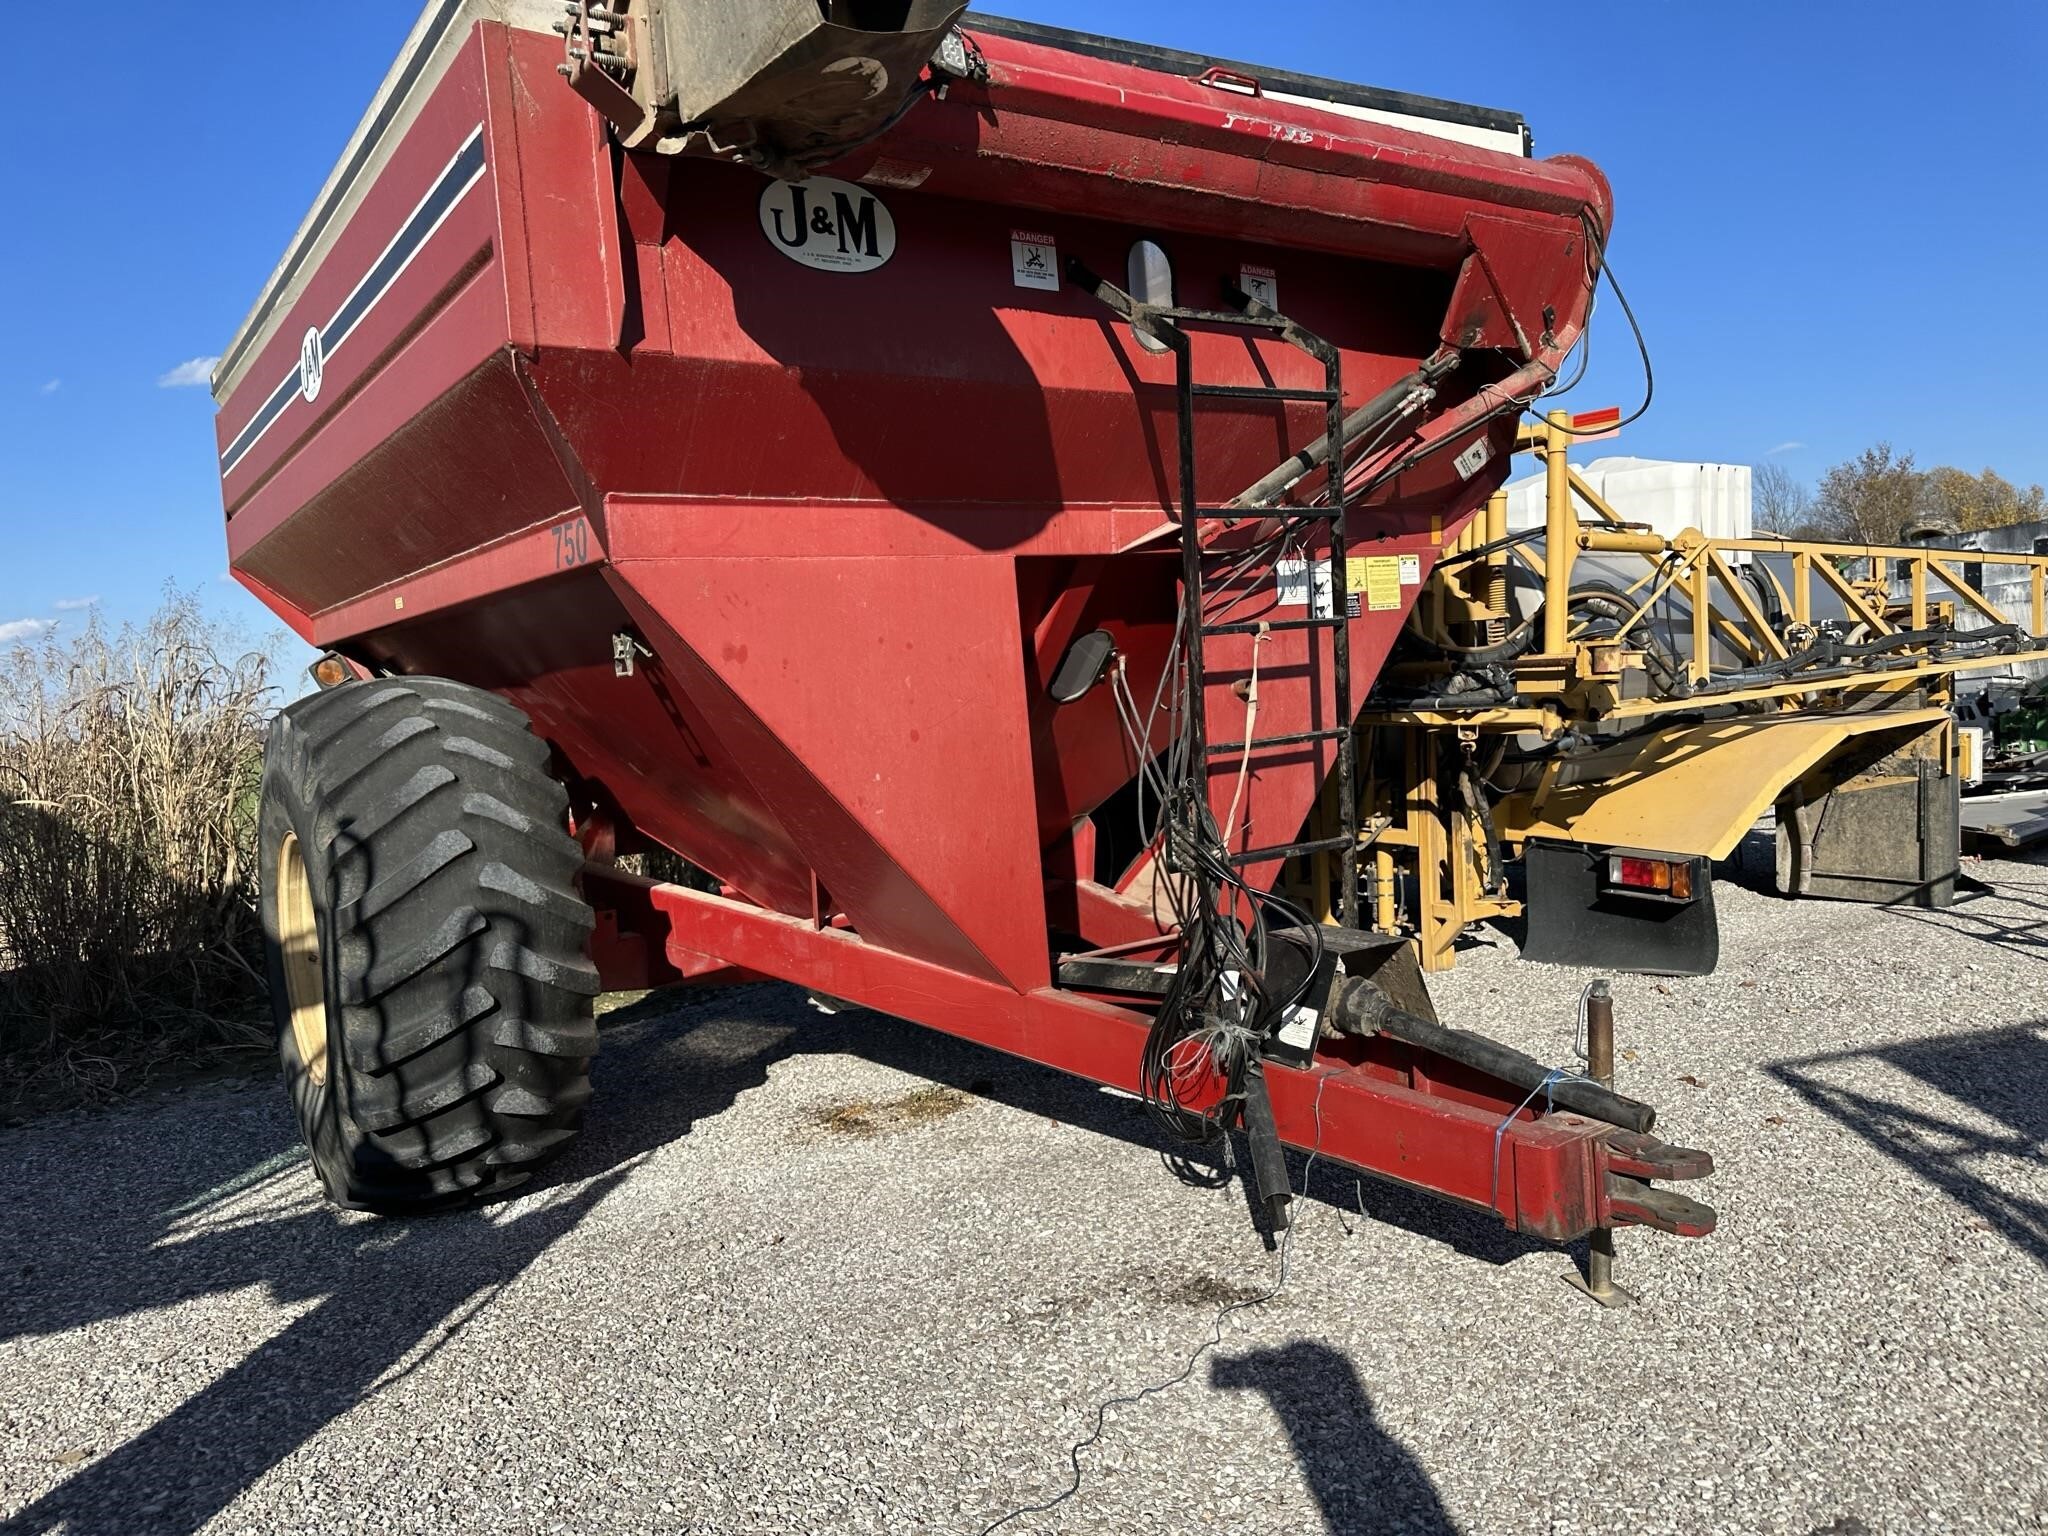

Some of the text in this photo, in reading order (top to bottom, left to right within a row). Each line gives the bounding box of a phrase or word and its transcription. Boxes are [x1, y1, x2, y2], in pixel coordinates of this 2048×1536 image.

[770, 184, 882, 258] J&M
[1019, 231, 1056, 246] DANGER
[1247, 266, 1275, 278] DANGER
[303, 332, 321, 392] J&M
[552, 519, 586, 568] 750
